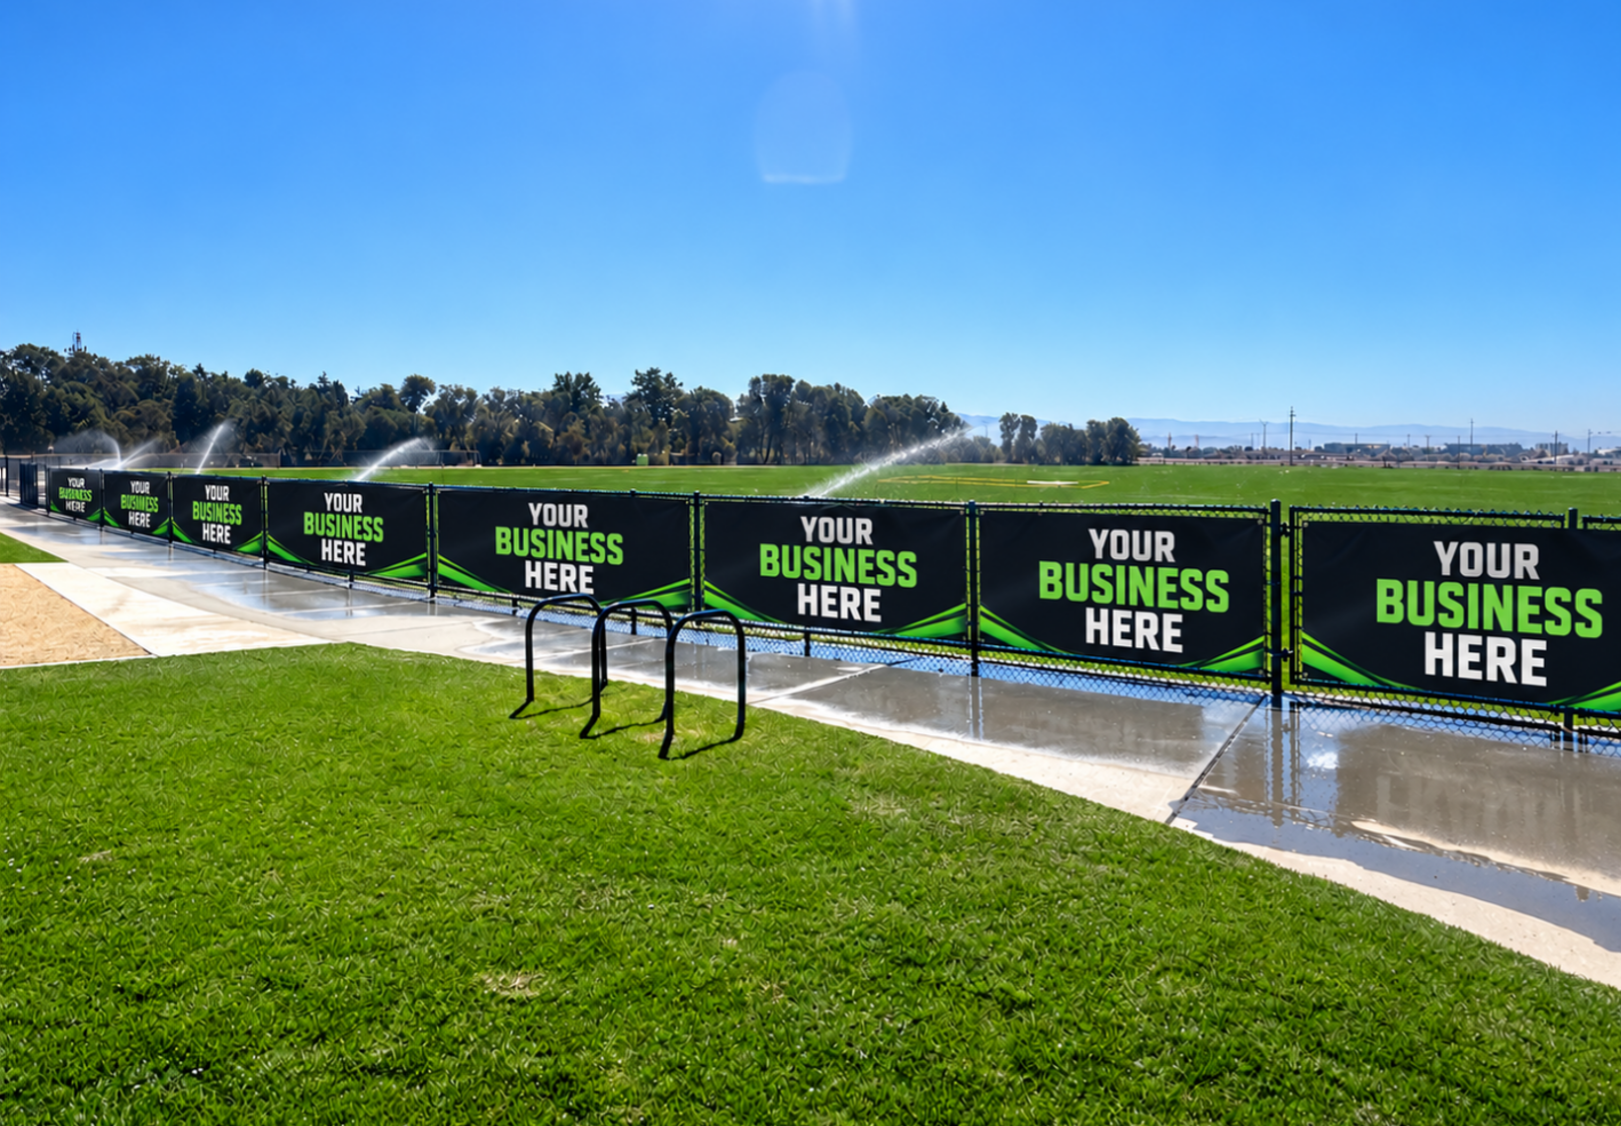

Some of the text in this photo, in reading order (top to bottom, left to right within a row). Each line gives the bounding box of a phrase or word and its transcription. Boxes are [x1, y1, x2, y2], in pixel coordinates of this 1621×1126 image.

[130, 481, 150, 494] YOUR
[204, 484, 230, 501] YOUR
[324, 492, 363, 514] YOUR
[128, 512, 151, 528] HERE
[192, 501, 242, 525] BUSINESS
[303, 512, 384, 543] BUSINESS
[528, 502, 588, 528] YOUR
[202, 523, 231, 545] HERE
[495, 526, 624, 566] BUSINESS
[801, 516, 873, 545] YOUR
[1089, 528, 1176, 563] YOUR
[321, 540, 366, 567] HERE
[759, 543, 917, 588] BUSINESS
[1433, 540, 1540, 580] YOUR
[525, 560, 594, 595] HERE
[1039, 560, 1229, 613] BUSINESS
[797, 582, 881, 623] HERE
[1376, 578, 1603, 639] BUSINESS
[1085, 607, 1183, 653] HERE
[1424, 632, 1547, 687] HERE
